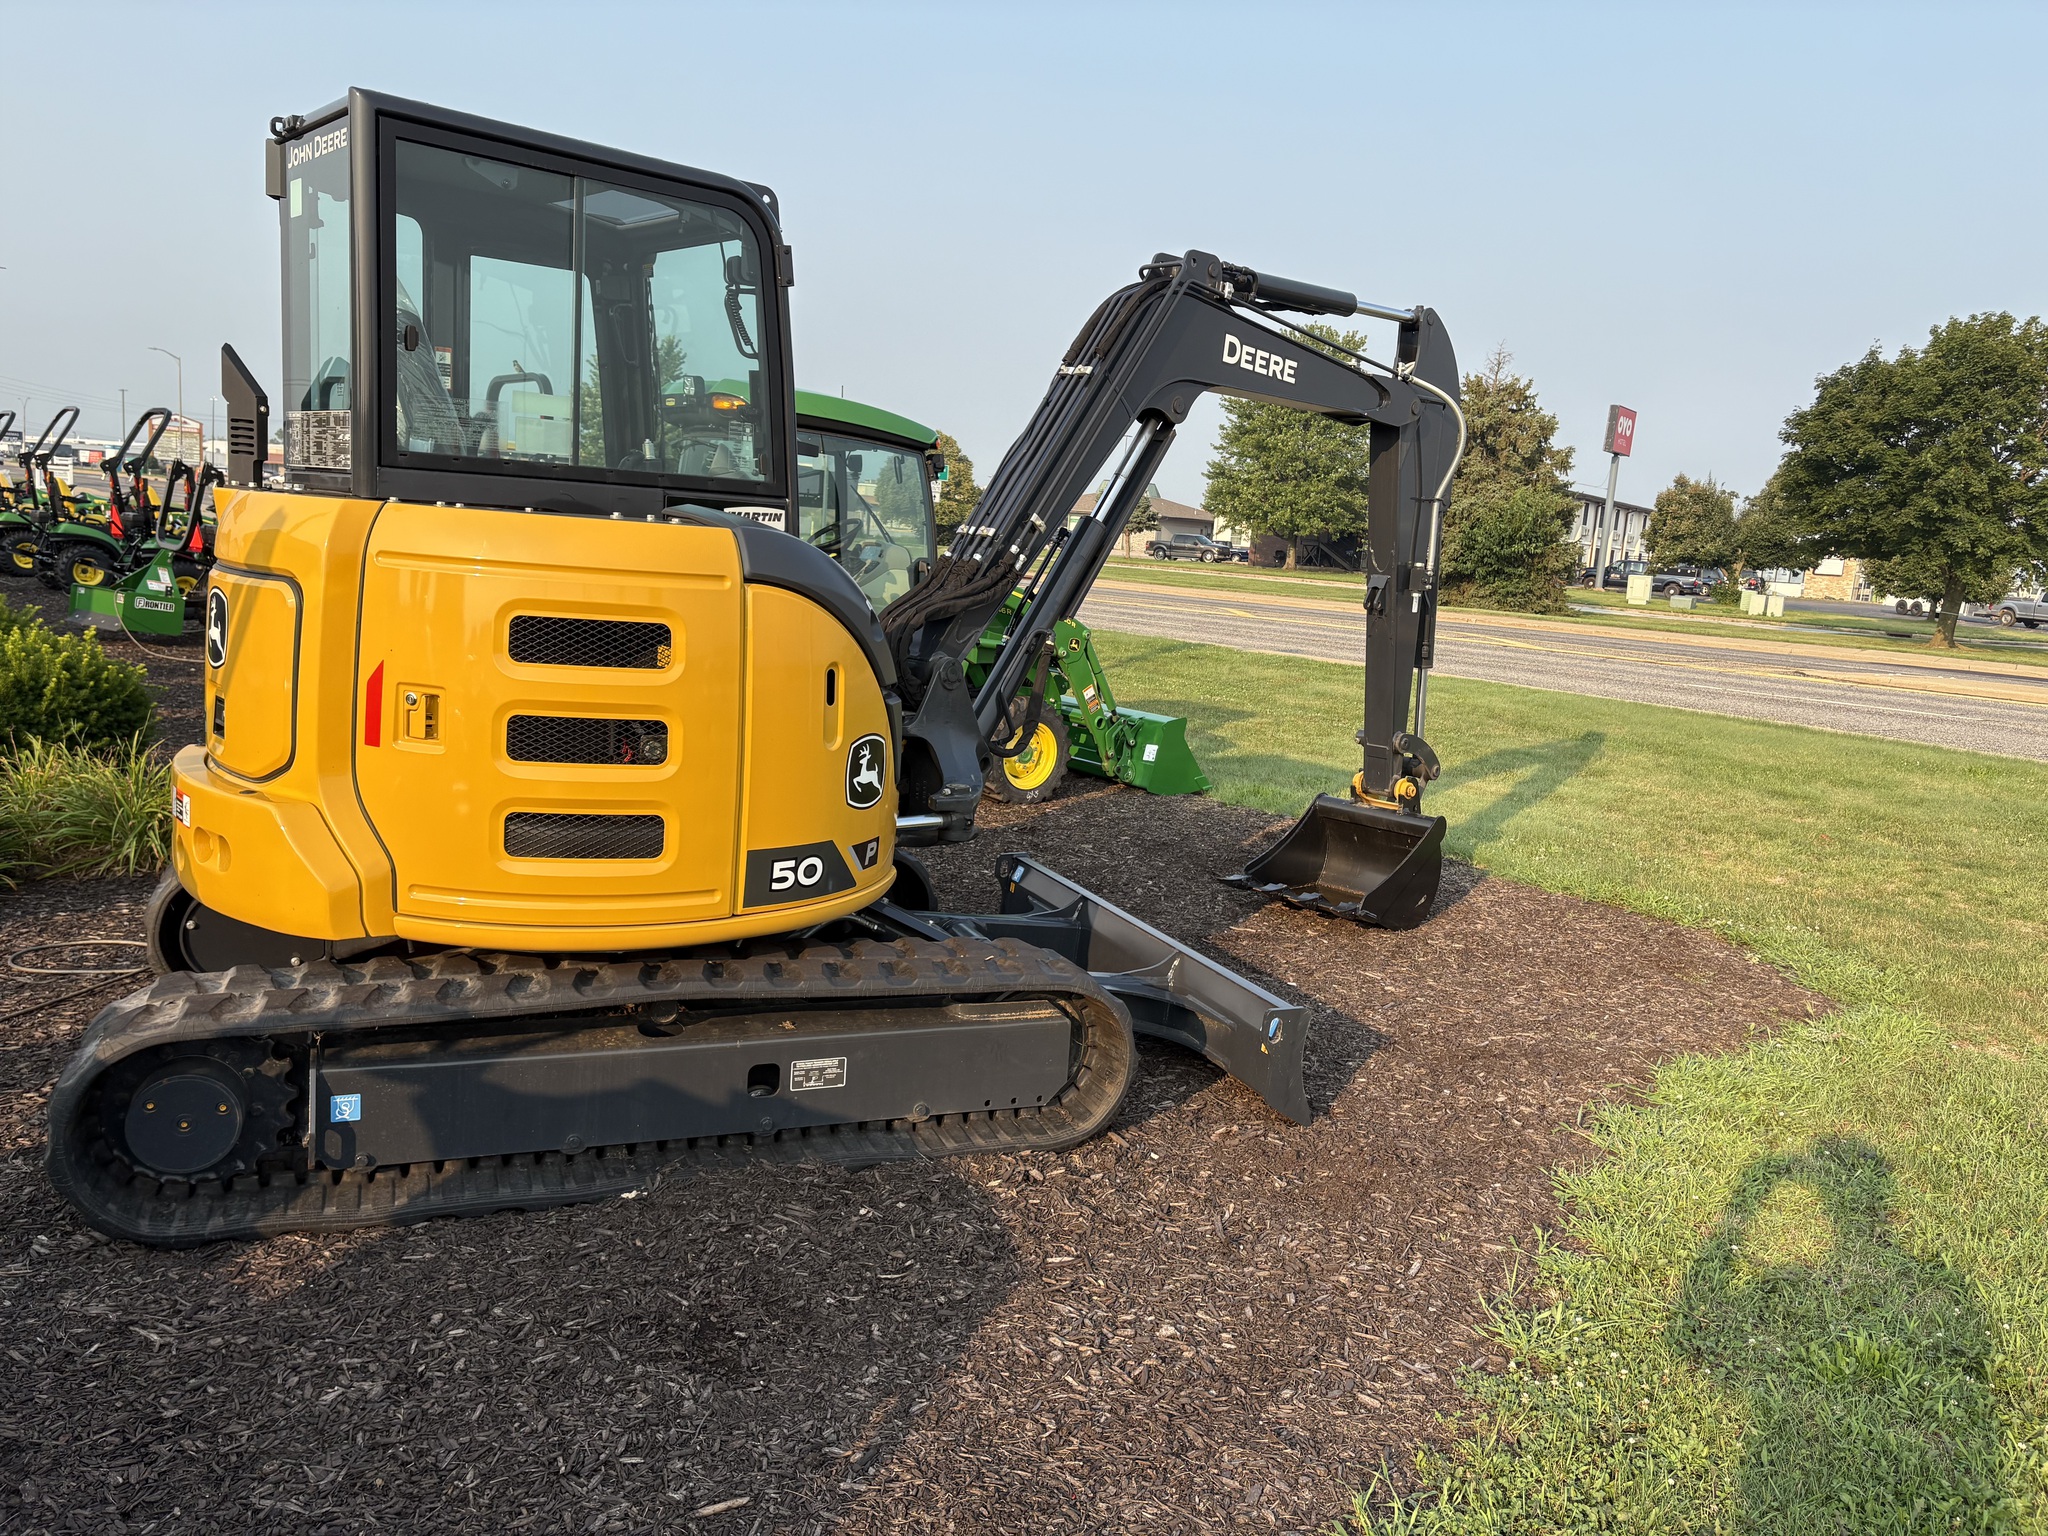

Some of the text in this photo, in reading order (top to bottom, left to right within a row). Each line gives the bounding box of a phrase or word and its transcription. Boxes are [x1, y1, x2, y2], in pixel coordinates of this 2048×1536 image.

[288, 127, 348, 169] JOHN DEERE
[1222, 333, 1298, 384] DEERE
[1617, 415, 1633, 437] OYO
[135, 597, 174, 611] FRONTIER
[864, 841, 878, 866] P
[770, 856, 824, 891] 50
